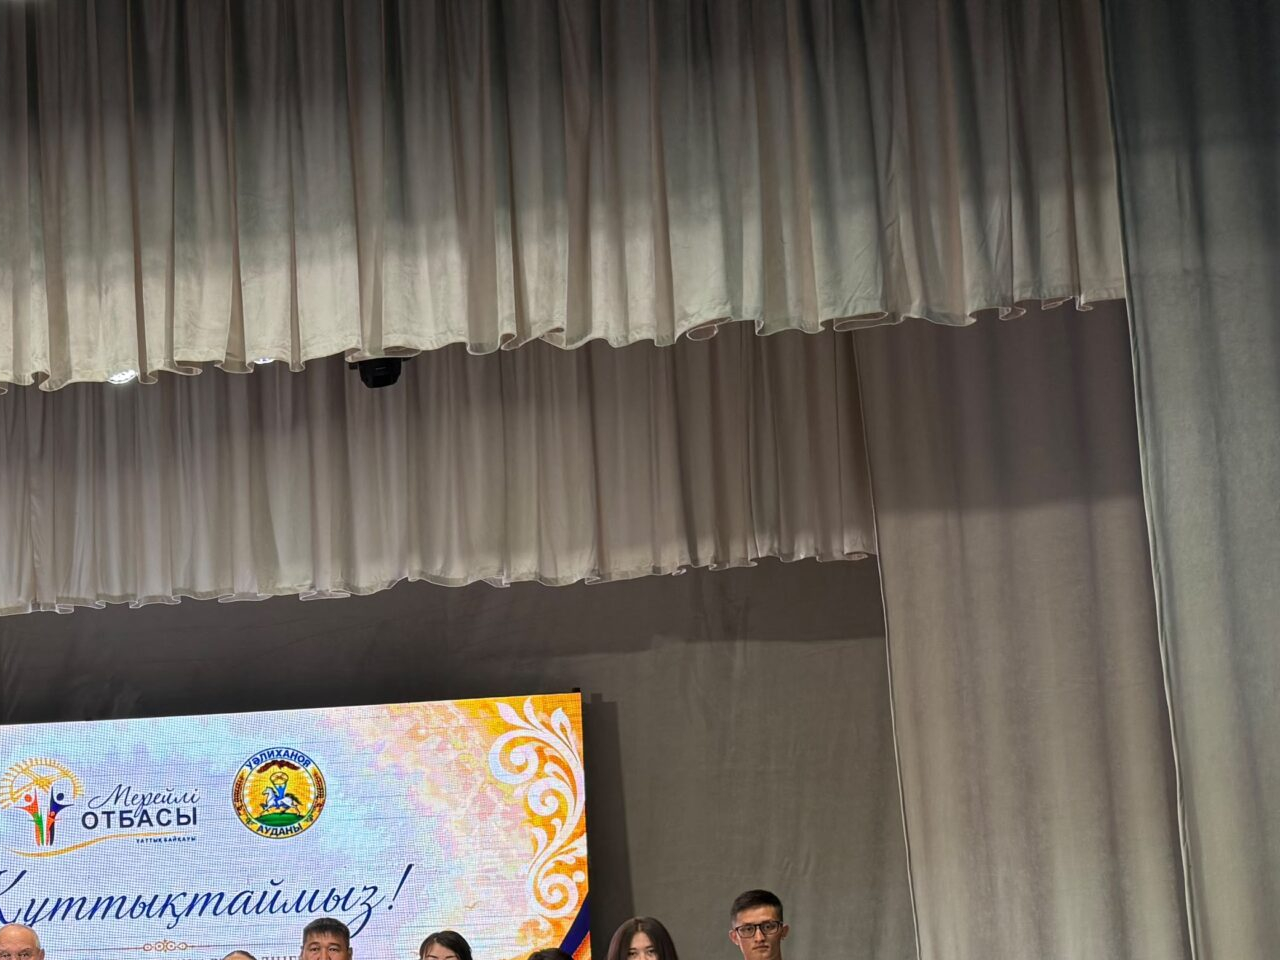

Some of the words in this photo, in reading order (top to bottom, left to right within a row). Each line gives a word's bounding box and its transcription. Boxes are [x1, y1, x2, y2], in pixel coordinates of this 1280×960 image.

[88, 784, 200, 817] Мерейлі
[81, 807, 197, 830] ОТБАСЫ
[256, 823, 303, 837] АУДАНЫ
